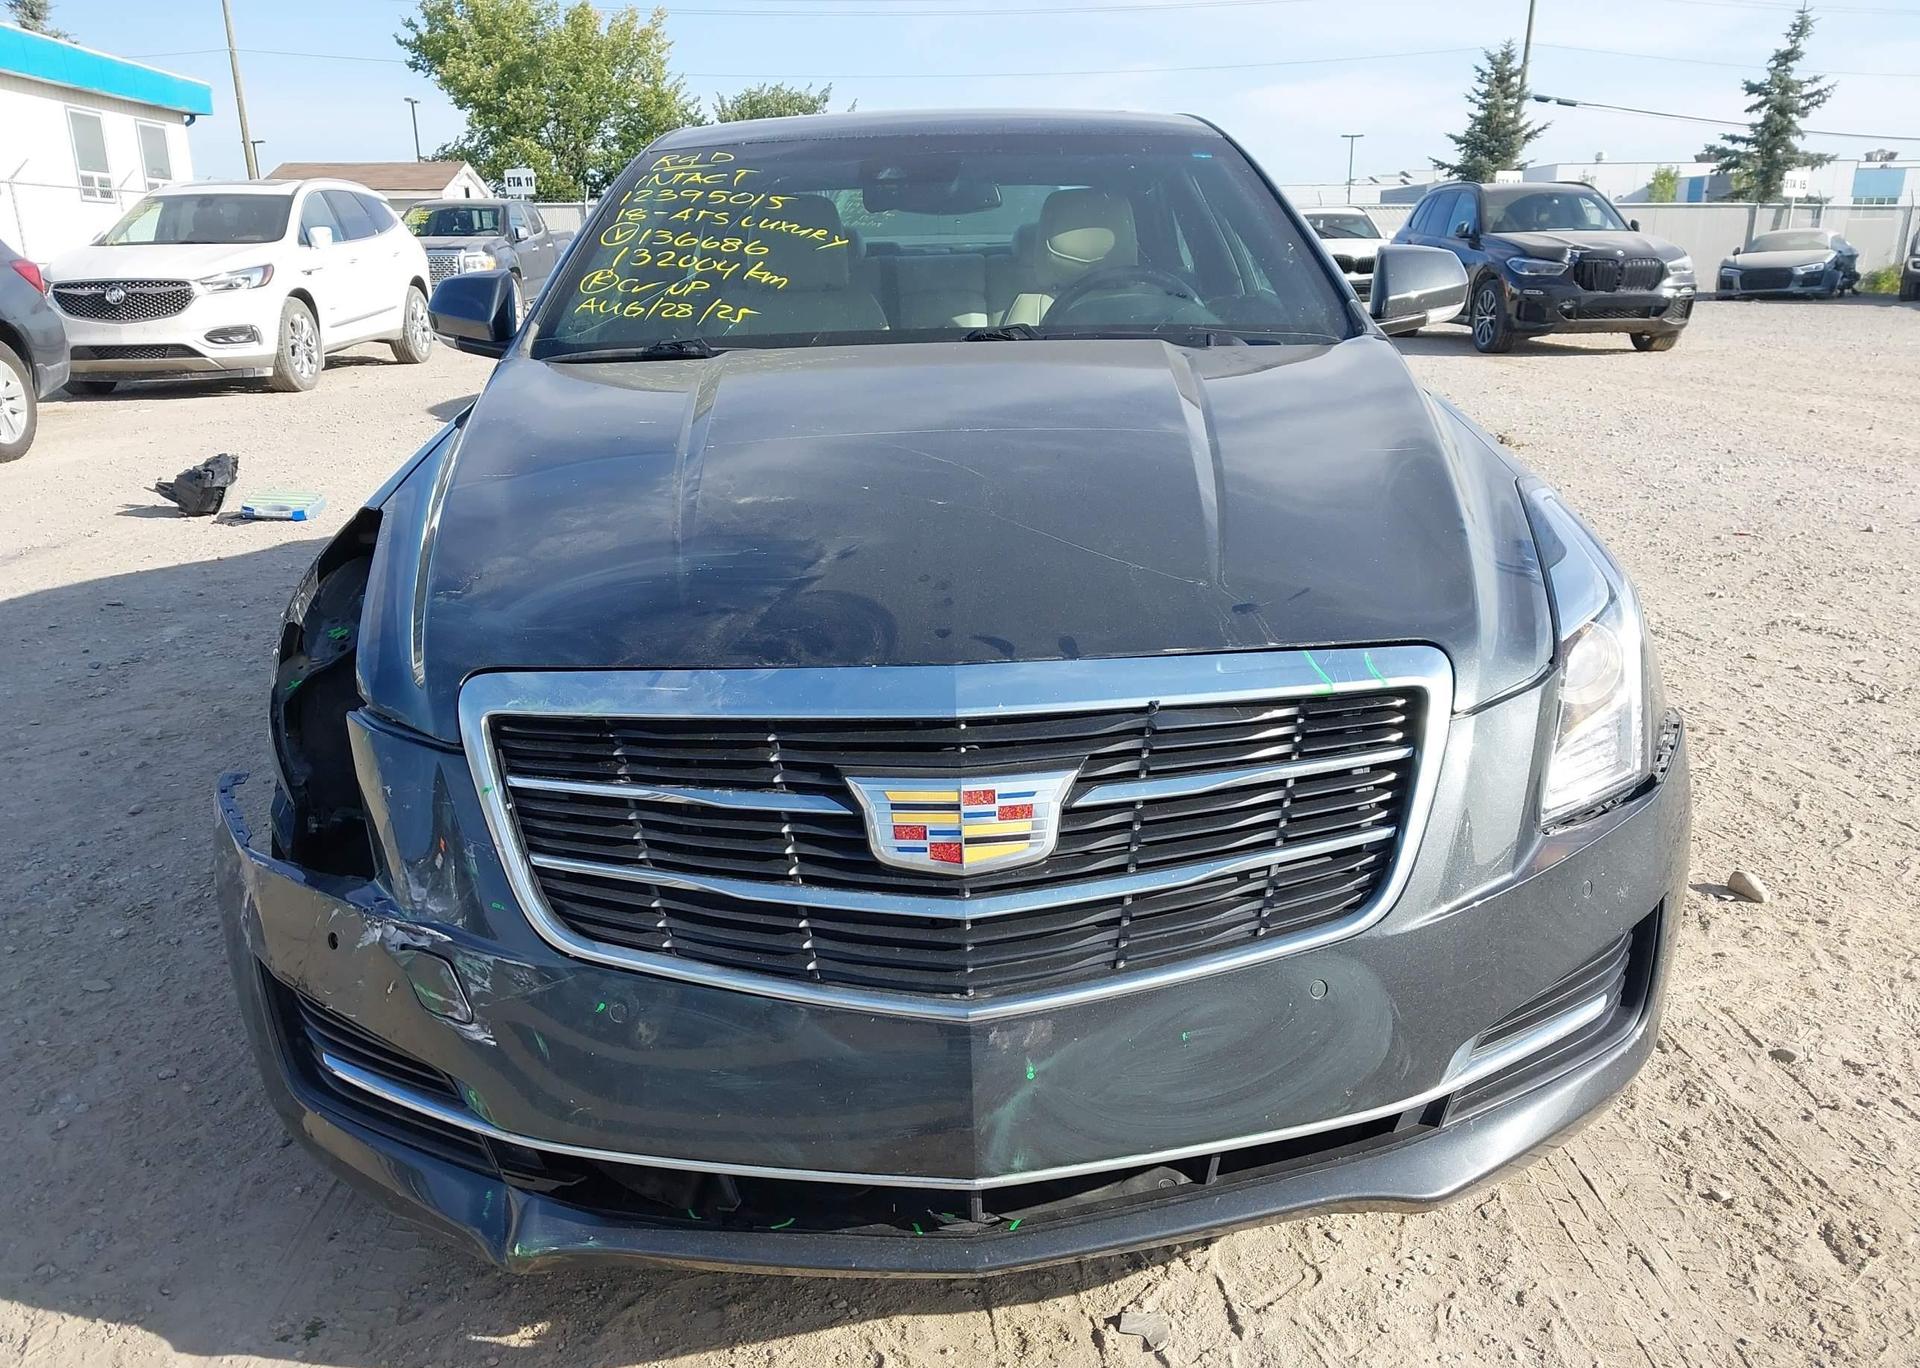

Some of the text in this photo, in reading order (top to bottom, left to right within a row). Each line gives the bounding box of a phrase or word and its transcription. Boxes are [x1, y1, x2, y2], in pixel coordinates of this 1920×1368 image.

[507, 176, 533, 188] ETA 11
[635, 169, 761, 190] INTACT
[620, 189, 799, 210] 12395015
